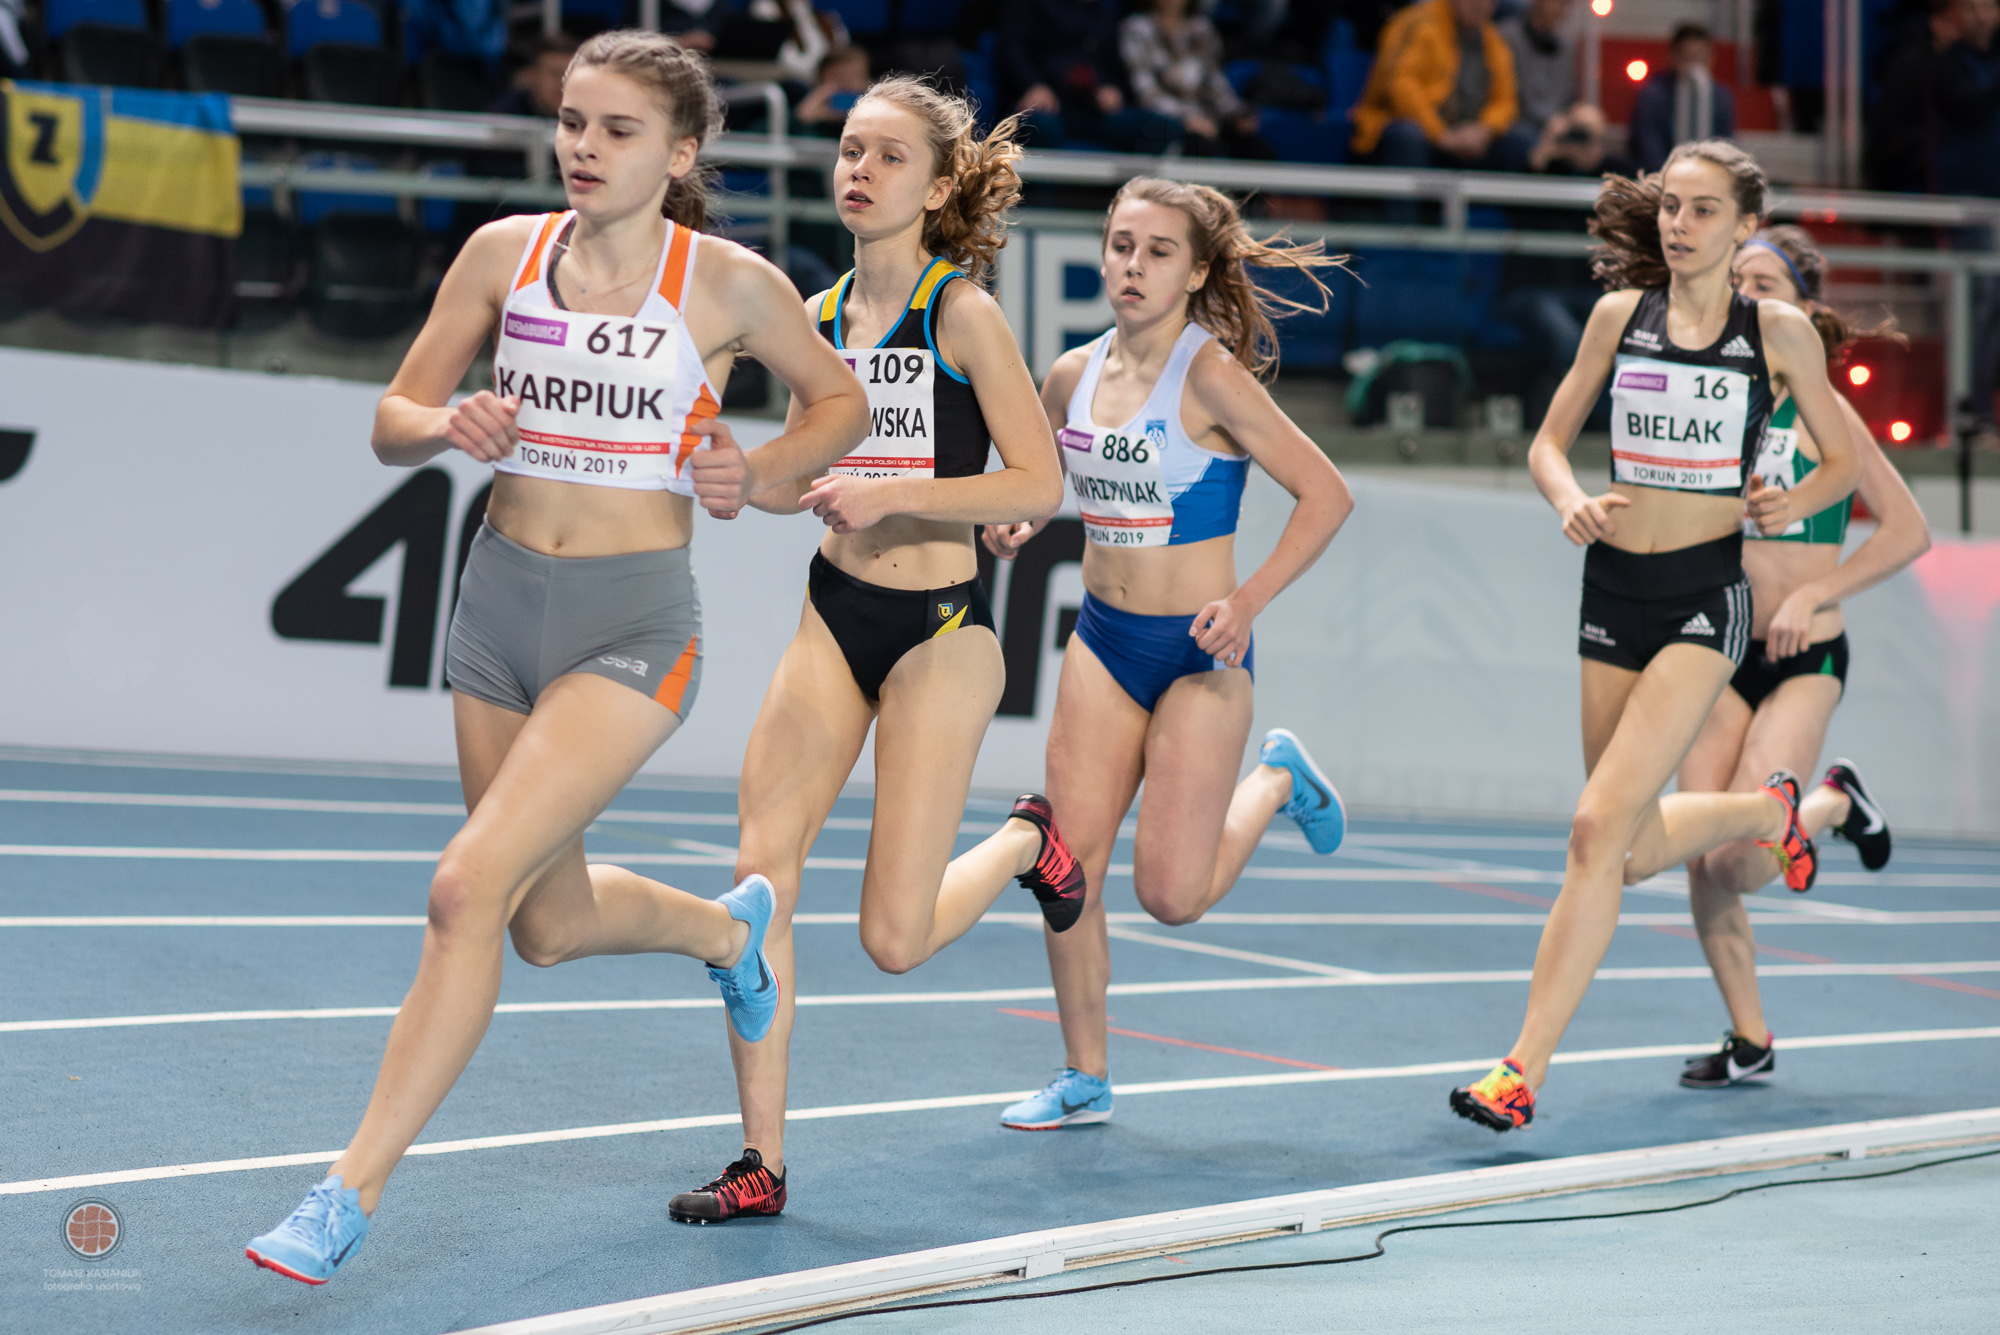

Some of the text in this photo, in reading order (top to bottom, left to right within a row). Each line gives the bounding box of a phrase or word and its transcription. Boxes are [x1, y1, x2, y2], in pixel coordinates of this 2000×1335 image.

[28, 109, 60, 165] Z
[587, 321, 667, 359] 617
[869, 353, 924, 384] 109
[499, 366, 665, 420] KARPIUK
[1694, 374, 1729, 400] 16
[1627, 412, 1723, 443] BIELAK
[521, 446, 628, 474] TORUŃ 2019
[1102, 434, 1149, 464] 886
[1634, 466, 1713, 484] TORUŃ 2019
[1113, 531, 1144, 544] 2019
